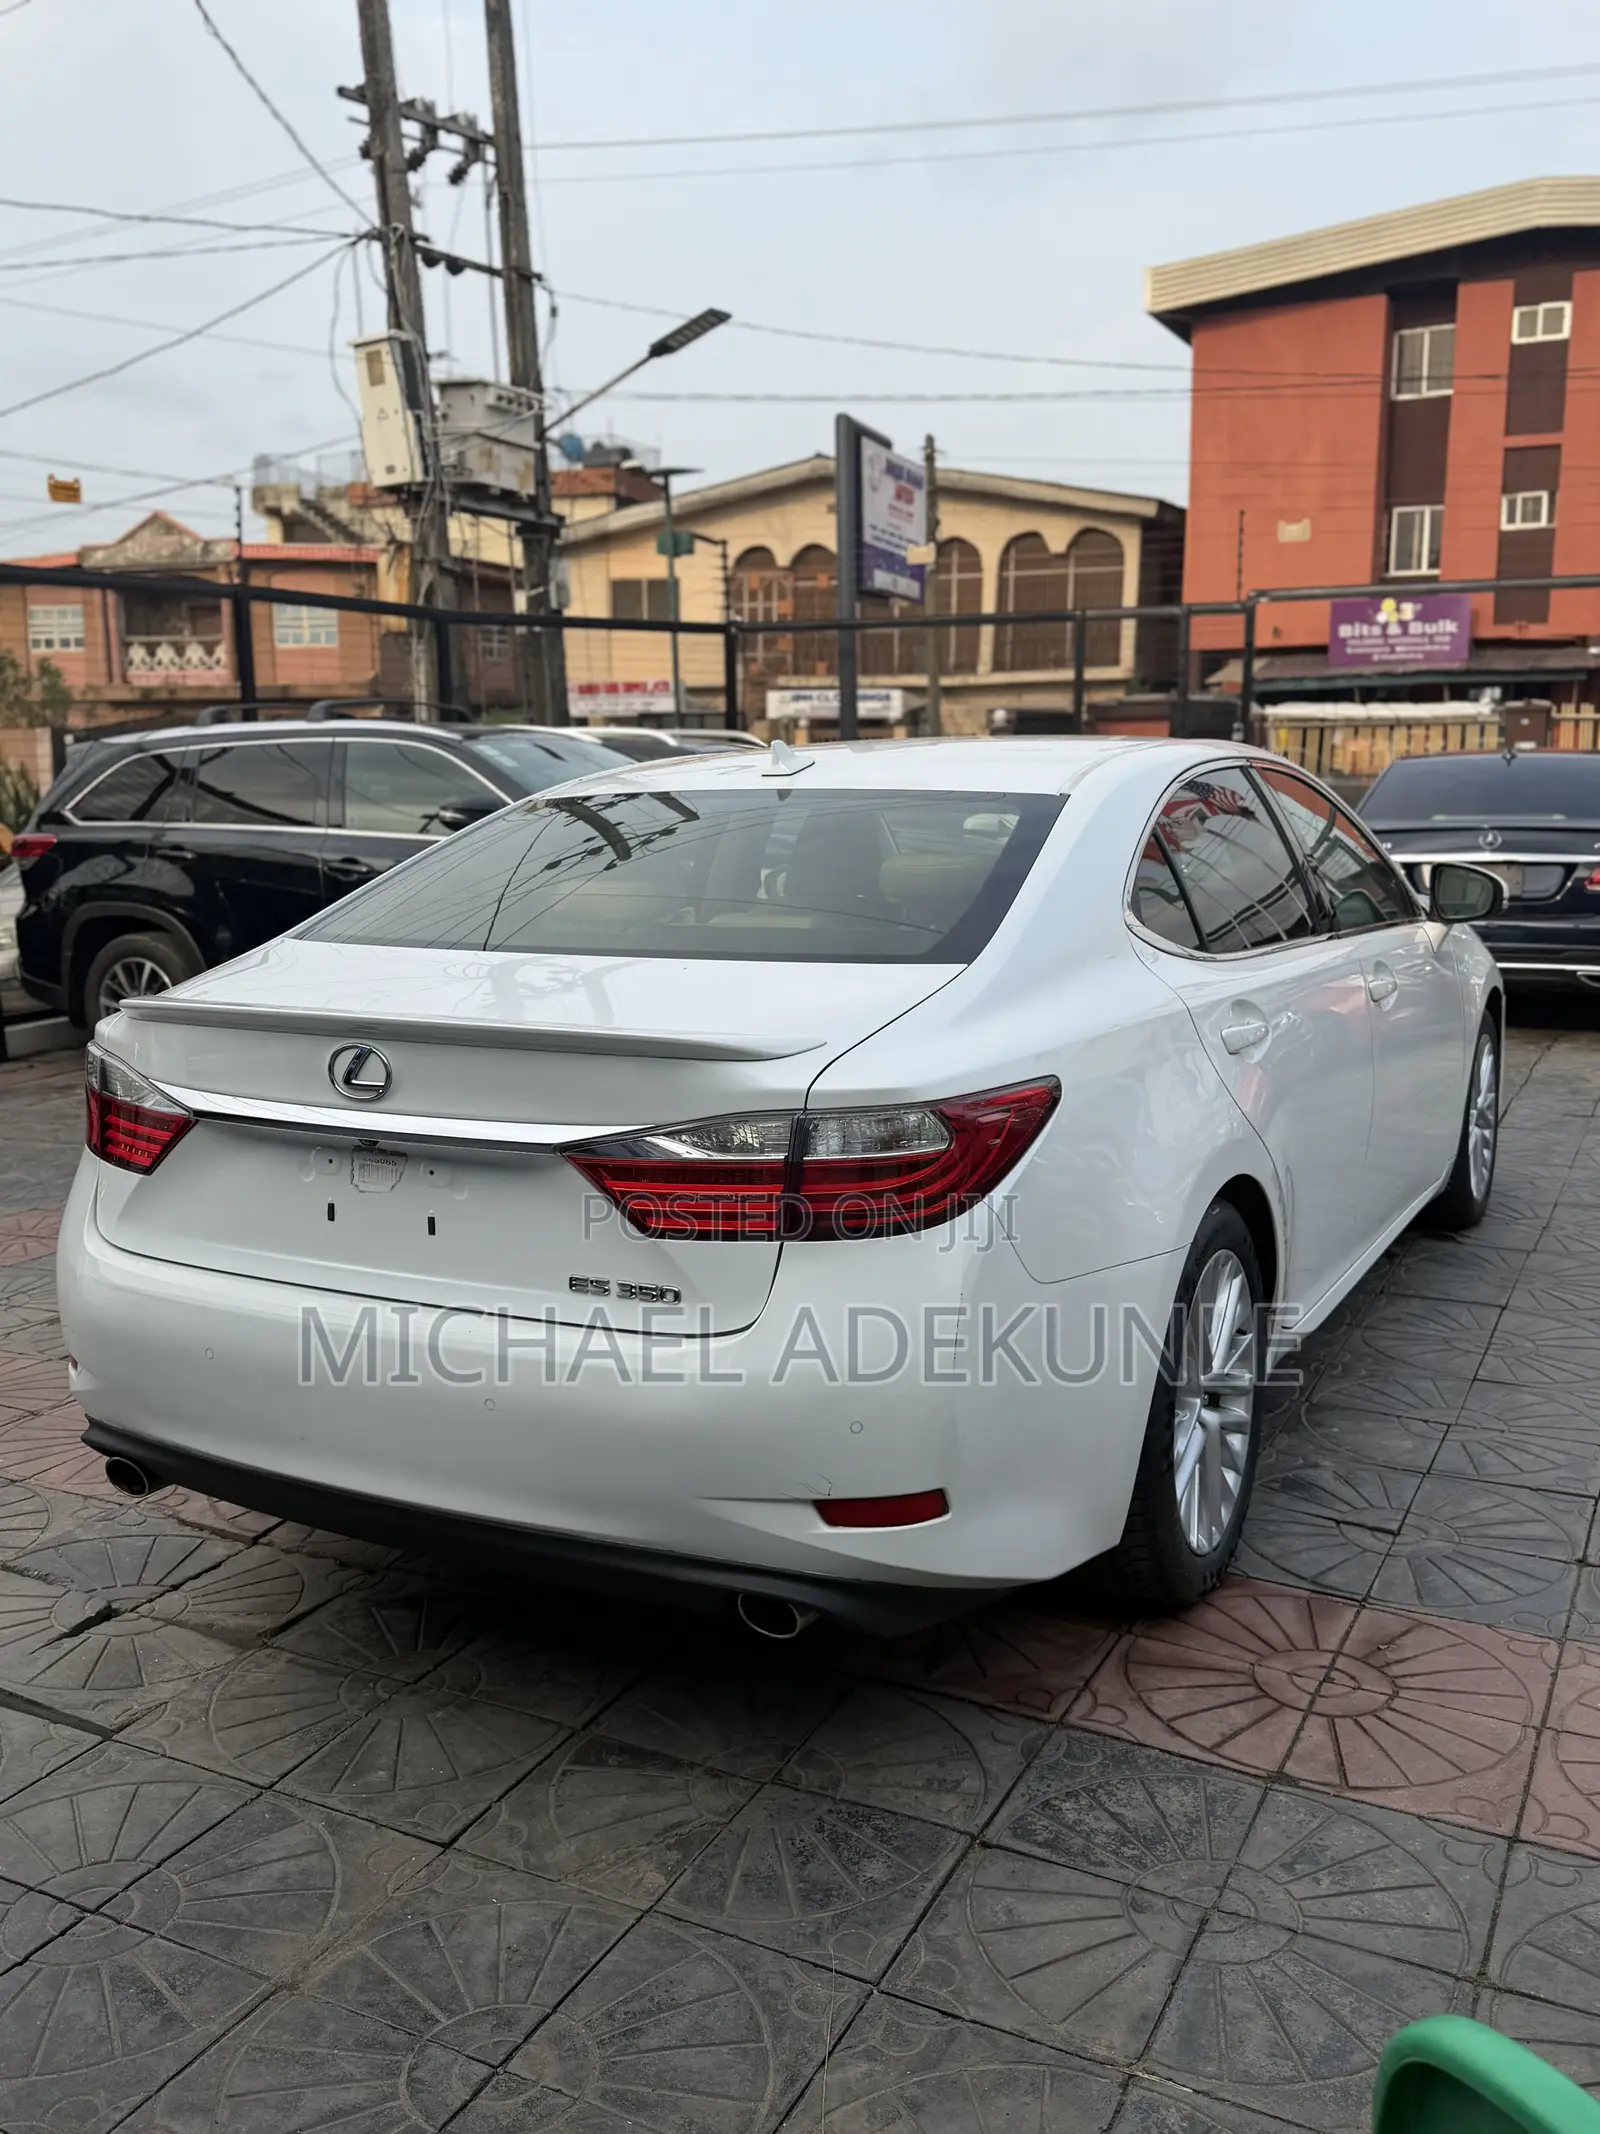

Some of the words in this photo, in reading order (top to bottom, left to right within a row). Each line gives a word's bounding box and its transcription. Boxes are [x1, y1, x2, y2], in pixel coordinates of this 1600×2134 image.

[1408, 618, 1459, 635] Bulk
[569, 1274, 610, 1296] ES
[616, 1280, 681, 1305] 350
